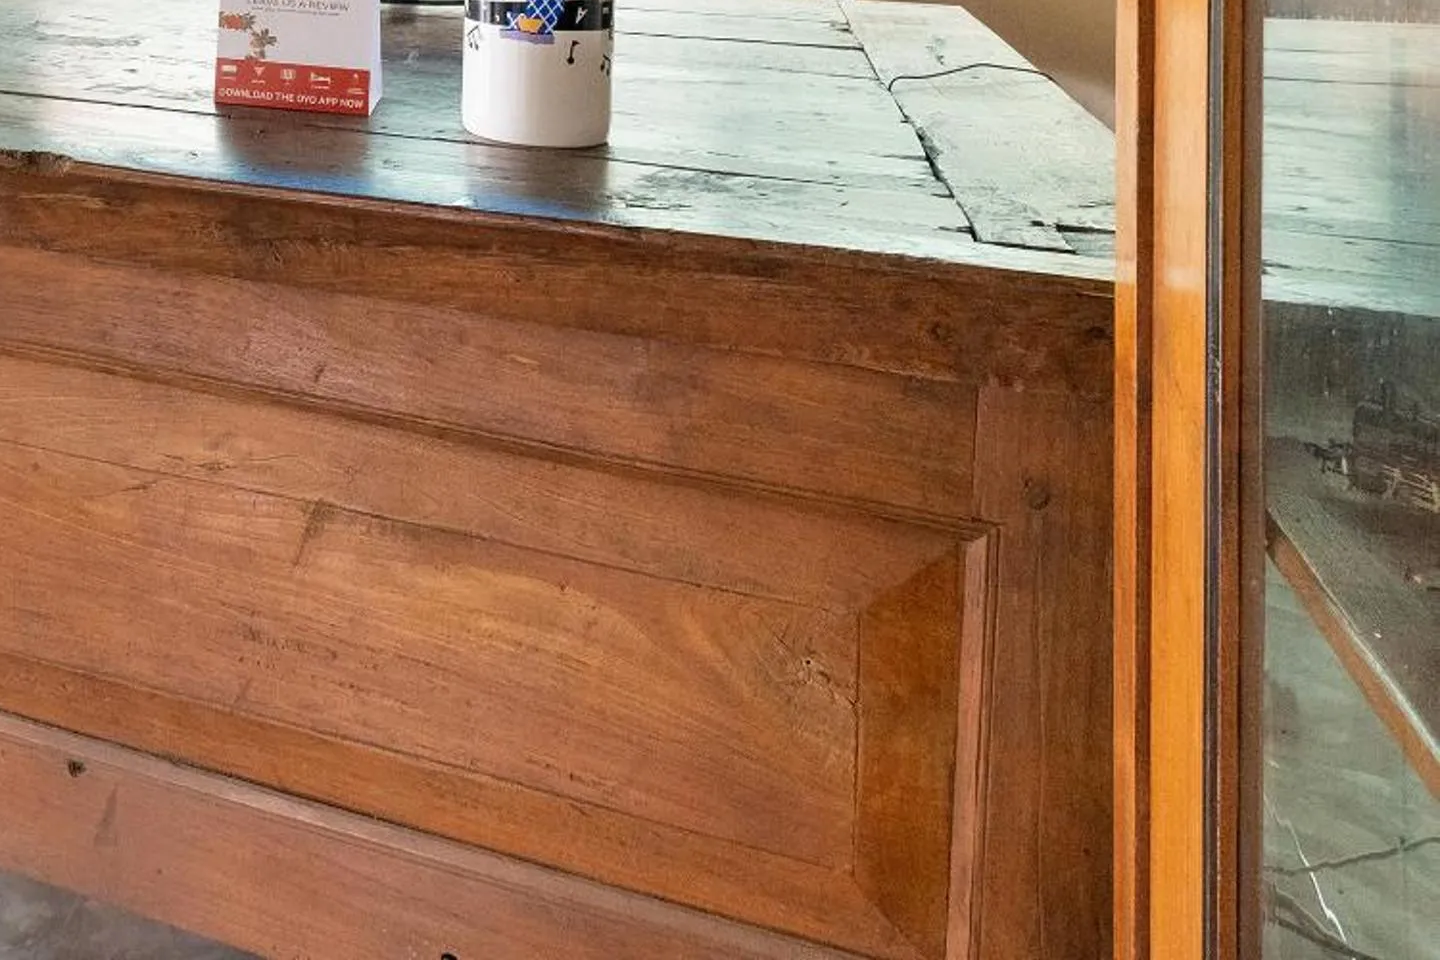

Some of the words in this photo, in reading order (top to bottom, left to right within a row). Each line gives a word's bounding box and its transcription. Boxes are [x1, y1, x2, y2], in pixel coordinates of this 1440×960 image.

[308, 0, 350, 12] REVIEW
[219, 87, 273, 101] DOWNLOAD
[275, 92, 294, 103] THE
[318, 96, 338, 107] APP
[339, 98, 364, 109] NOW
